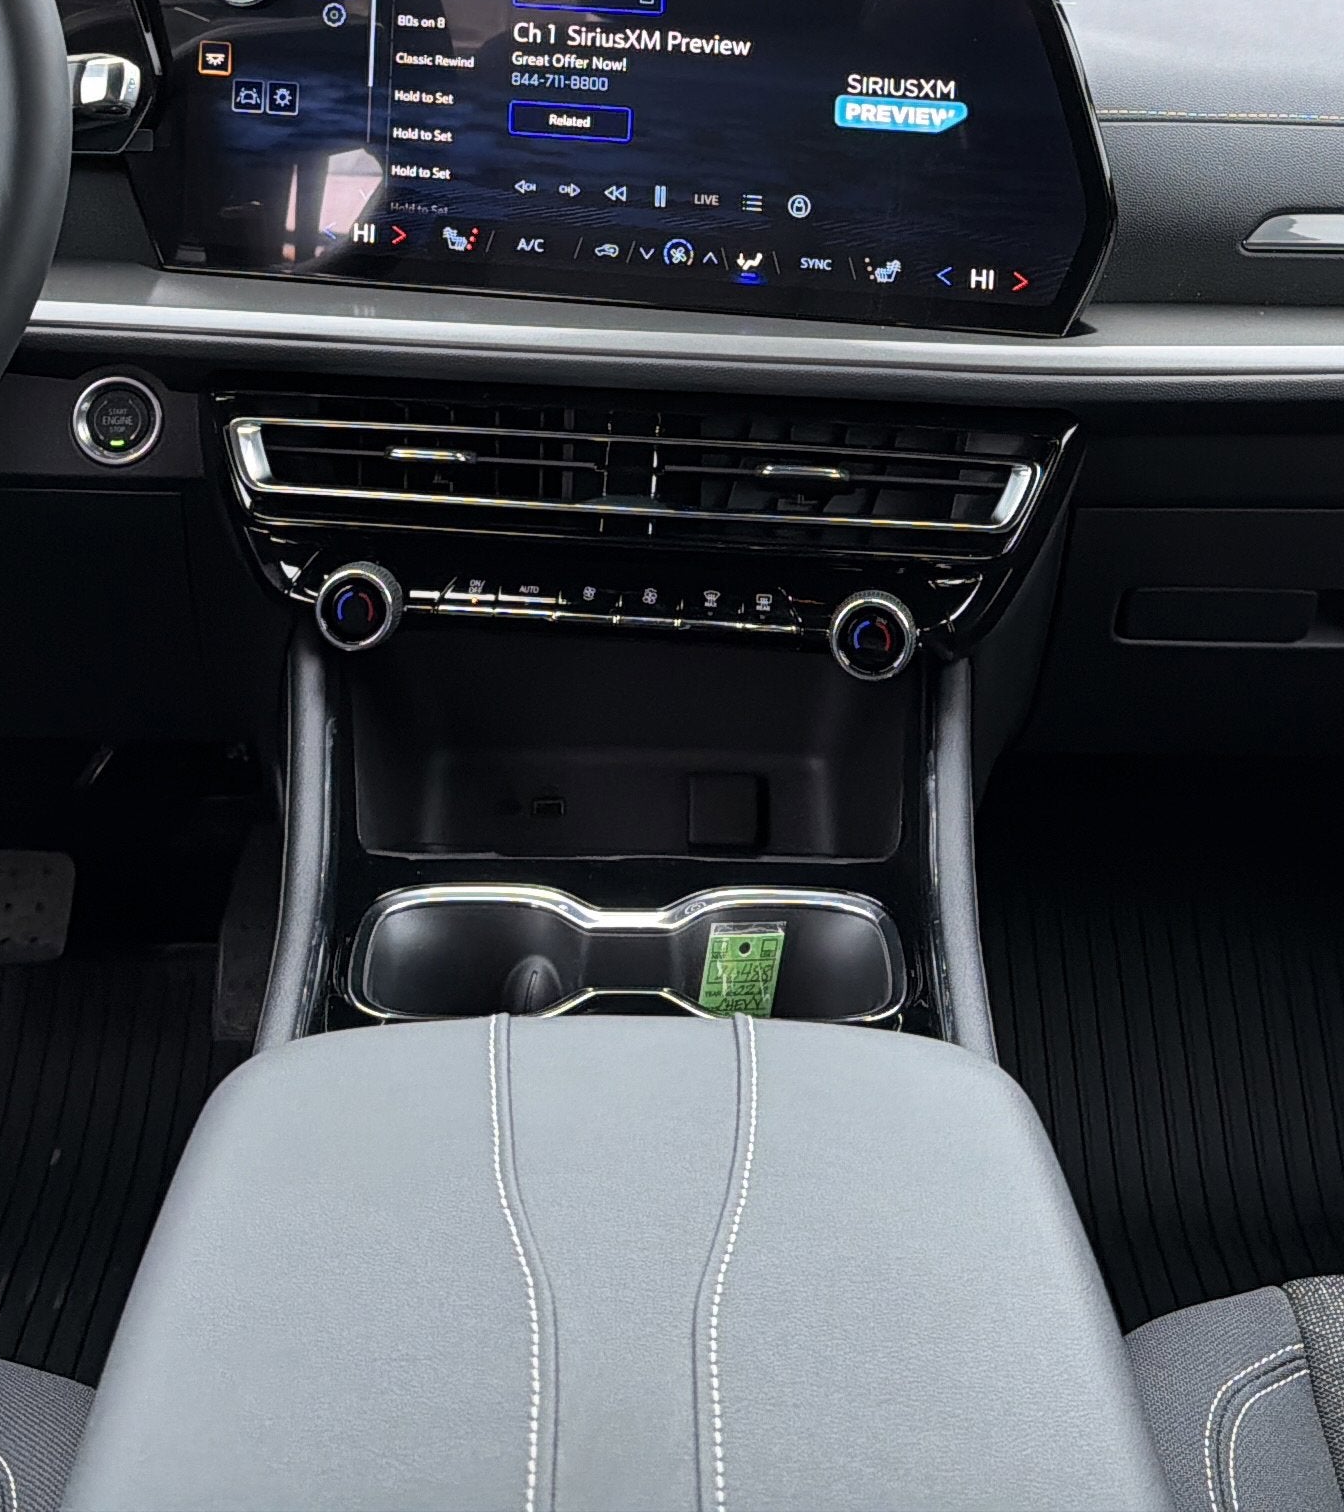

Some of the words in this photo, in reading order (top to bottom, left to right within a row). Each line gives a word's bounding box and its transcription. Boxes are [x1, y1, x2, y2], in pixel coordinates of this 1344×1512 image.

[397, 15, 419, 27] 80s
[421, 19, 435, 28] on
[437, 17, 446, 29] 8
[513, 22, 542, 44] Ch
[549, 24, 555, 44] 1
[567, 25, 661, 51] SiriusXM
[667, 31, 752, 56] Preview
[395, 52, 432, 65] Classic
[435, 54, 475, 68] Rewind
[512, 52, 550, 67] Great
[553, 54, 590, 70] Offer
[592, 57, 627, 72] Now!
[512, 72, 609, 92] 844-711-8800
[847, 74, 955, 99] SIRIUSXM
[394, 90, 420, 103] Hold
[421, 92, 433, 103] to
[436, 92, 454, 105] Set
[549, 114, 591, 128] Related
[846, 103, 956, 126] PREVIEW
[393, 127, 418, 140] Hold
[420, 130, 432, 141] to
[433, 129, 453, 142] Set
[391, 165, 417, 177] Hold
[418, 168, 430, 178] to
[432, 167, 451, 180] Set
[694, 194, 719, 206] LIVE
[390, 202, 416, 214] Hold
[417, 205, 429, 215] to
[430, 205, 449, 215] Set
[353, 223, 376, 243] HI
[517, 238, 545, 253] A/C
[800, 257, 832, 271] SYNC
[970, 268, 995, 291] HI
[102, 416, 134, 425] ENGINE
[519, 585, 540, 594] AUTO
